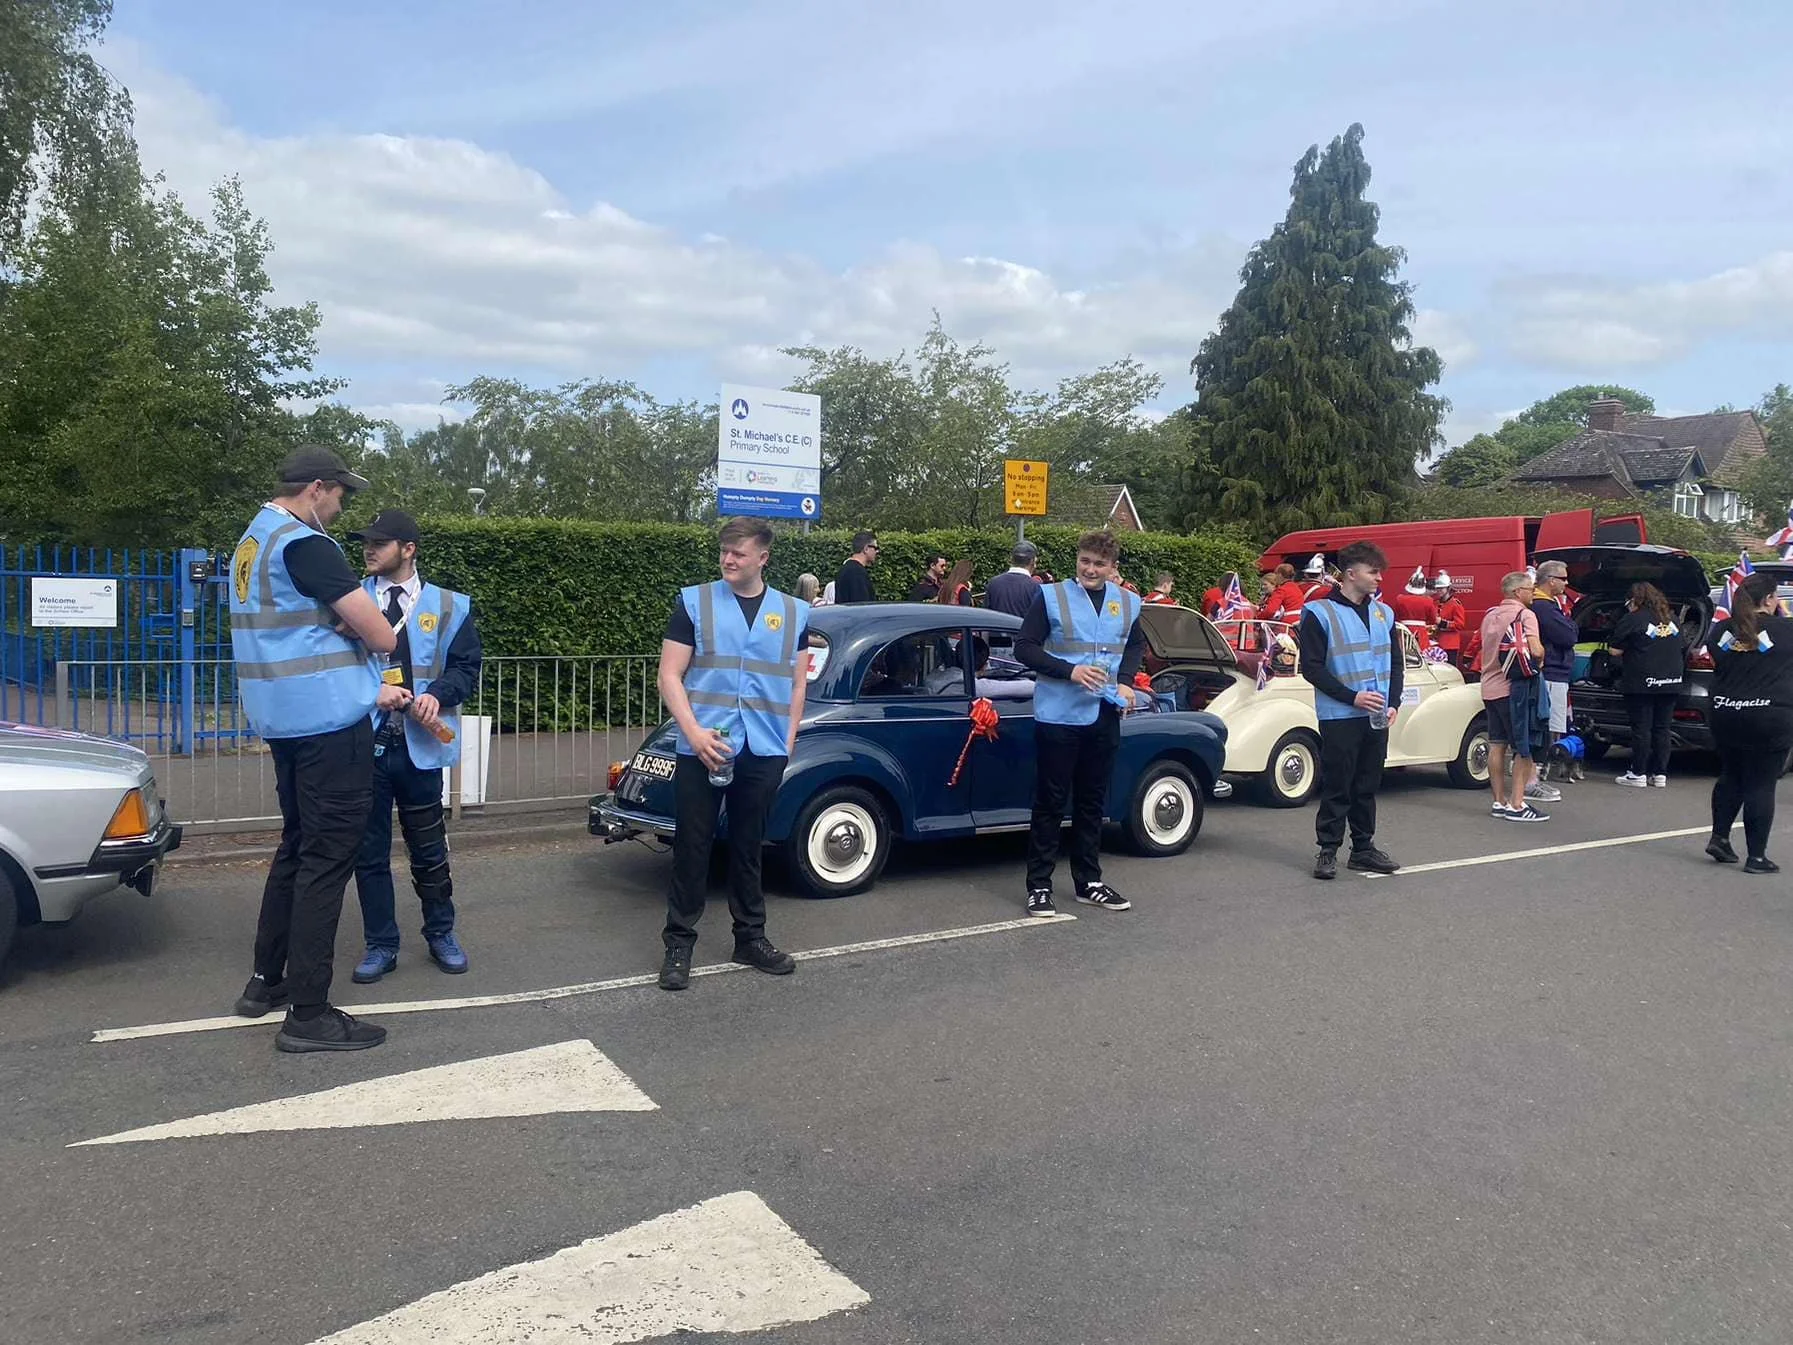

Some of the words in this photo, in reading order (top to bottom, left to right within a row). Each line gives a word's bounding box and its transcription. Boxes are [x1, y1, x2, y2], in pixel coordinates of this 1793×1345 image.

[730, 428, 742, 439] St.
[744, 429, 783, 443] Michael's
[801, 436, 812, 448] (C)
[730, 439, 762, 454] Primary
[763, 443, 790, 454] School
[1018, 474, 1045, 482] stopping
[1713, 695, 1771, 710] Flagacise
[632, 753, 652, 772] BLG
[649, 757, 677, 777] 999F
